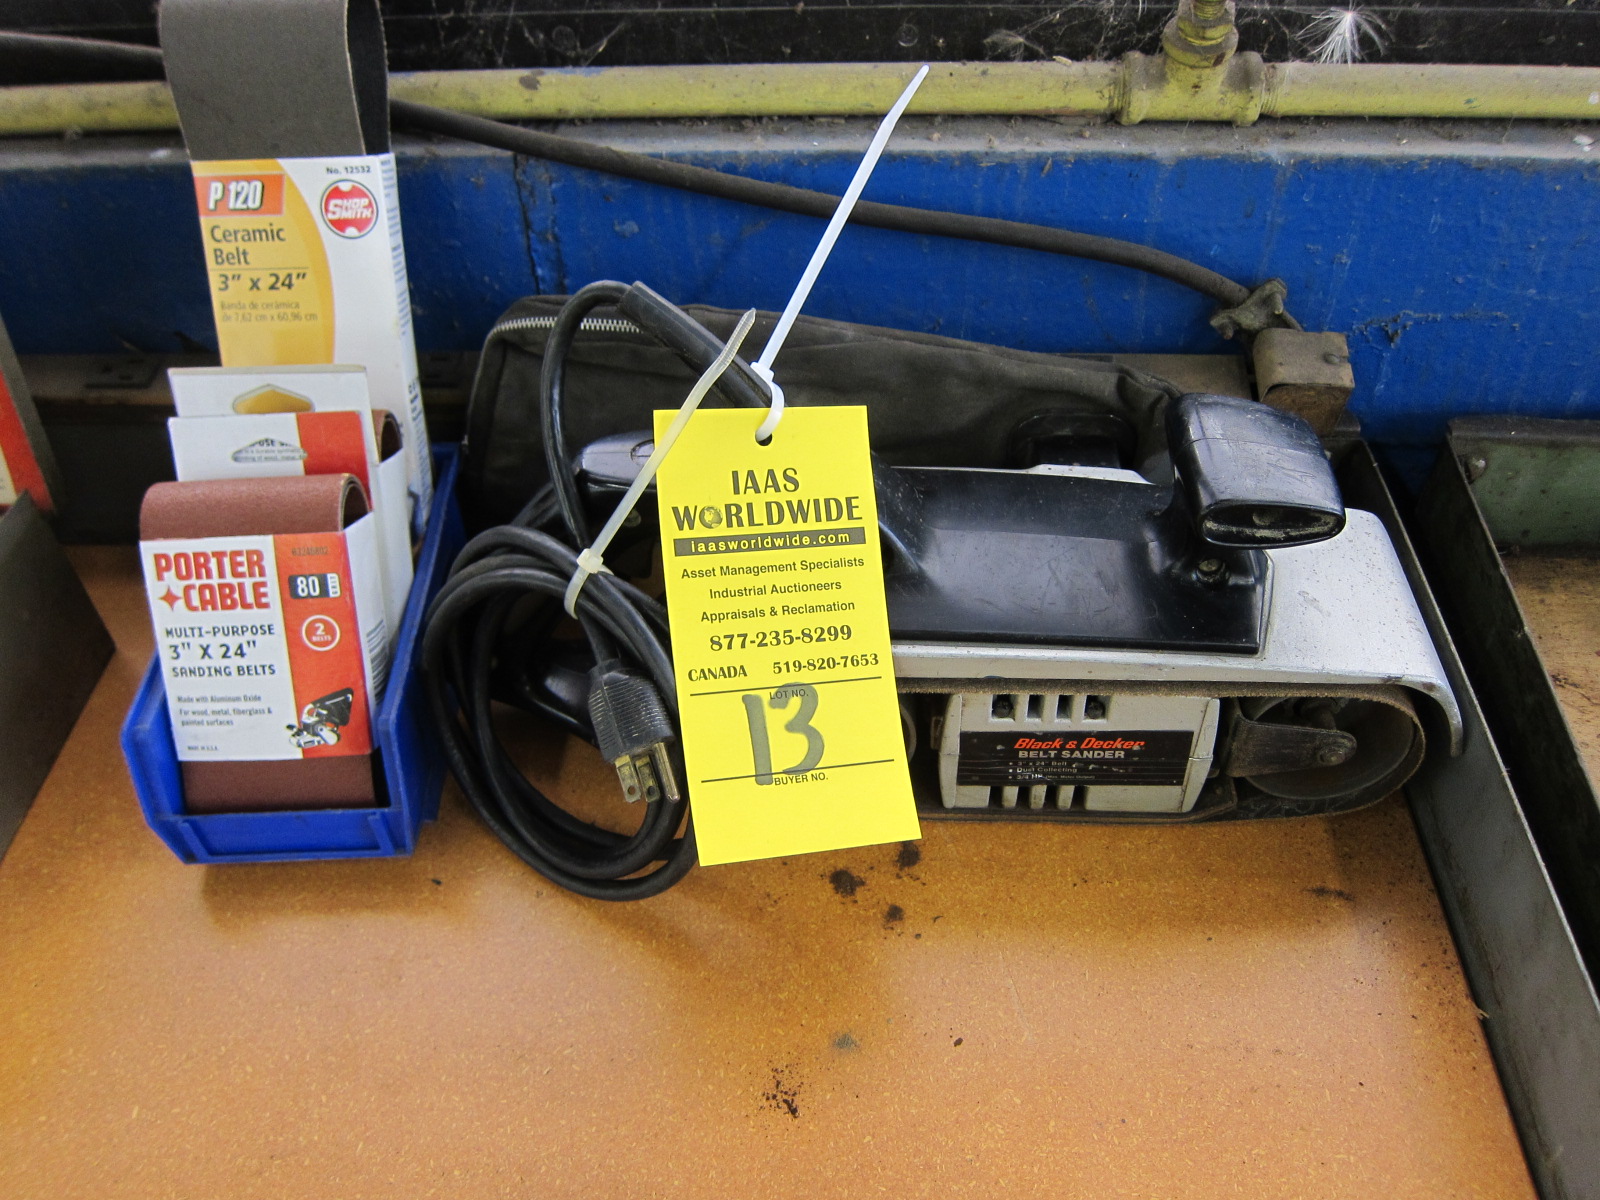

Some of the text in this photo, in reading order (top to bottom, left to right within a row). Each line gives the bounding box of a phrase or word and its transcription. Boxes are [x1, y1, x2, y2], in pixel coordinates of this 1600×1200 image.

[326, 165, 371, 175] No. 12532
[208, 179, 264, 211] P 120
[210, 223, 286, 243] Ceramic
[213, 247, 250, 266] Belt
[249, 277, 261, 291] x
[731, 467, 801, 495] IAAS
[671, 496, 863, 532] WORLDWIDE
[691, 533, 850, 553] iaasworldwide.com
[153, 549, 266, 581] PORTER
[681, 557, 865, 580] Asset Management Specialists
[296, 575, 320, 597] 80
[709, 580, 842, 600] Industrial Auctioneers
[183, 581, 271, 612] CABLE
[700, 601, 856, 624] Appraisals & Reclamation
[165, 623, 275, 638] MULTI-PURPOSE
[314, 622, 325, 635] 2
[710, 624, 852, 652] 877-235-8299
[170, 641, 191, 660] 3"
[219, 640, 257, 659] 24"
[172, 664, 276, 678] SANDING BELTS
[688, 653, 879, 682] CANADA 519-820-7653
[769, 688, 809, 700] LOT NO.
[742, 682, 825, 786] 13
[1014, 737, 1146, 750] Black & Decker
[1018, 750, 1126, 759] BELT SANDER
[774, 772, 829, 786] BUYER NO.
